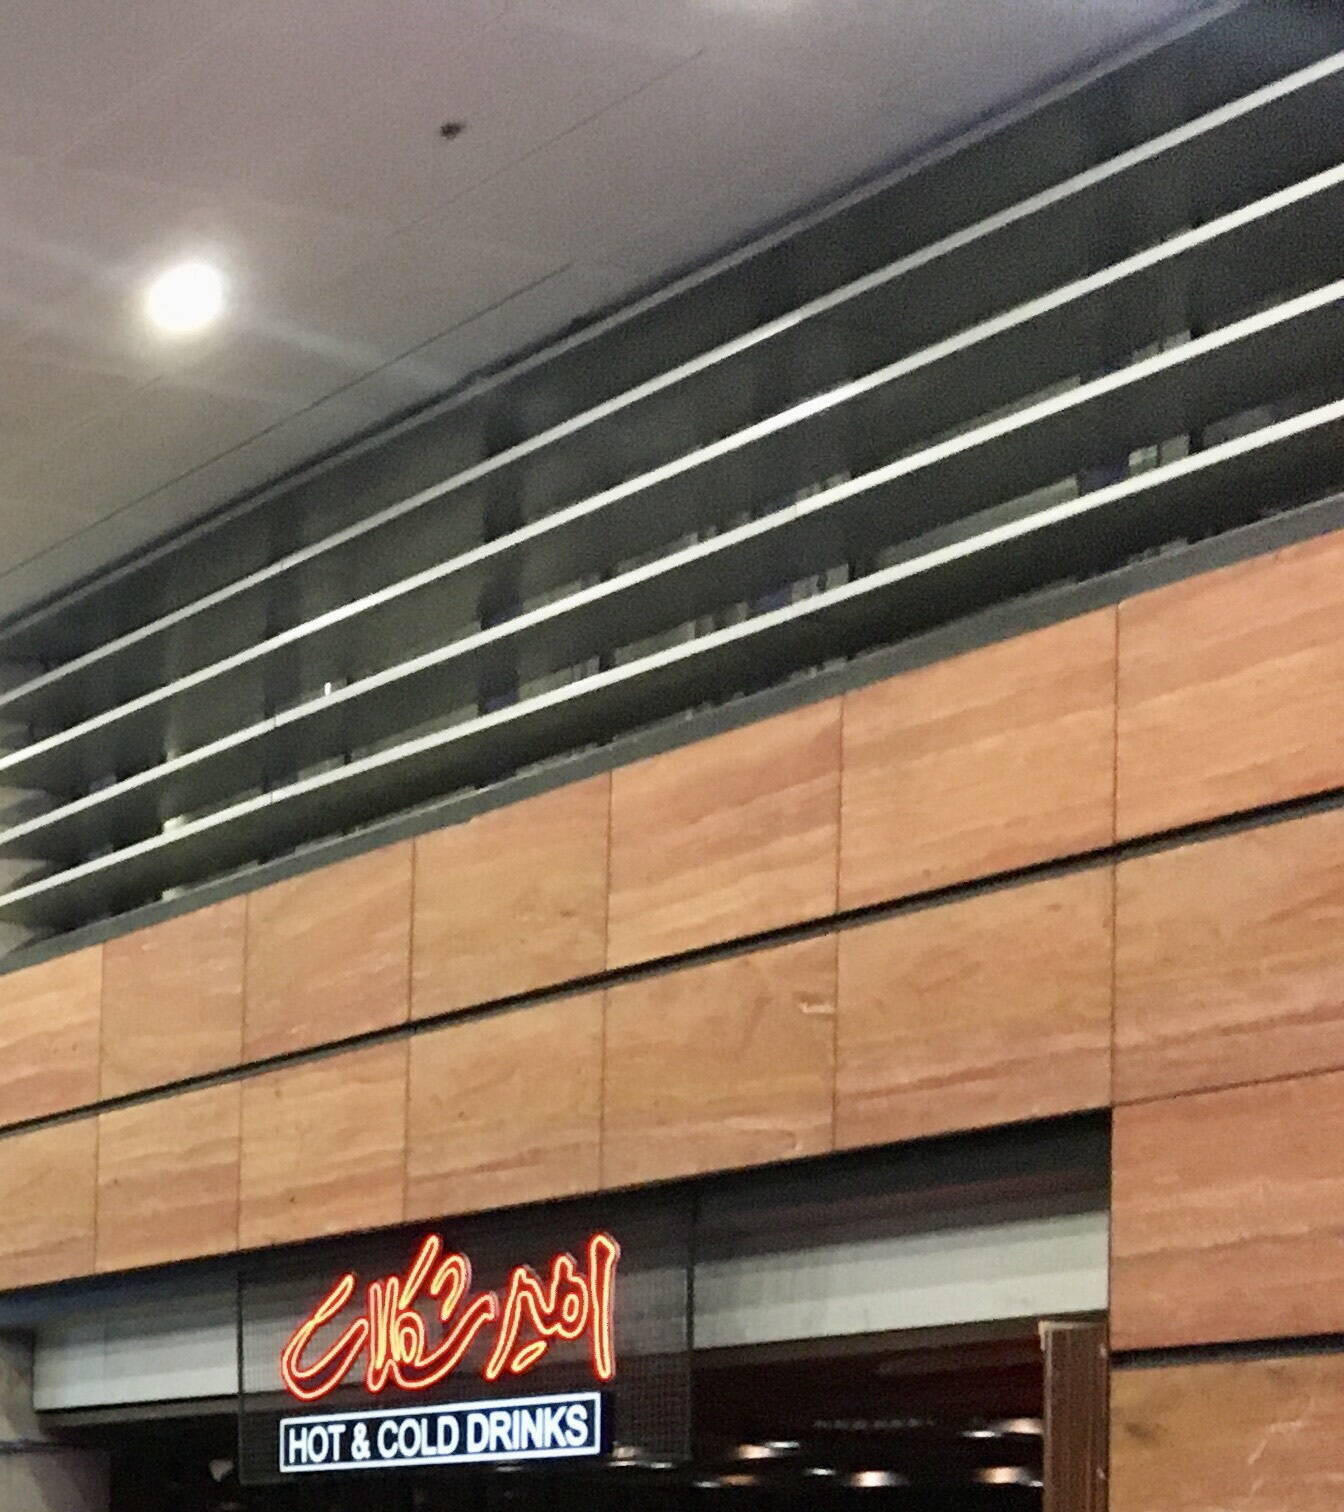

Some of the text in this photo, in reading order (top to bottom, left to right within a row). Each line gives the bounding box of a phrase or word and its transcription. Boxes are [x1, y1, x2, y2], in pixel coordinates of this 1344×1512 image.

[287, 1404, 589, 1465] HOT & COLD DRINKS
